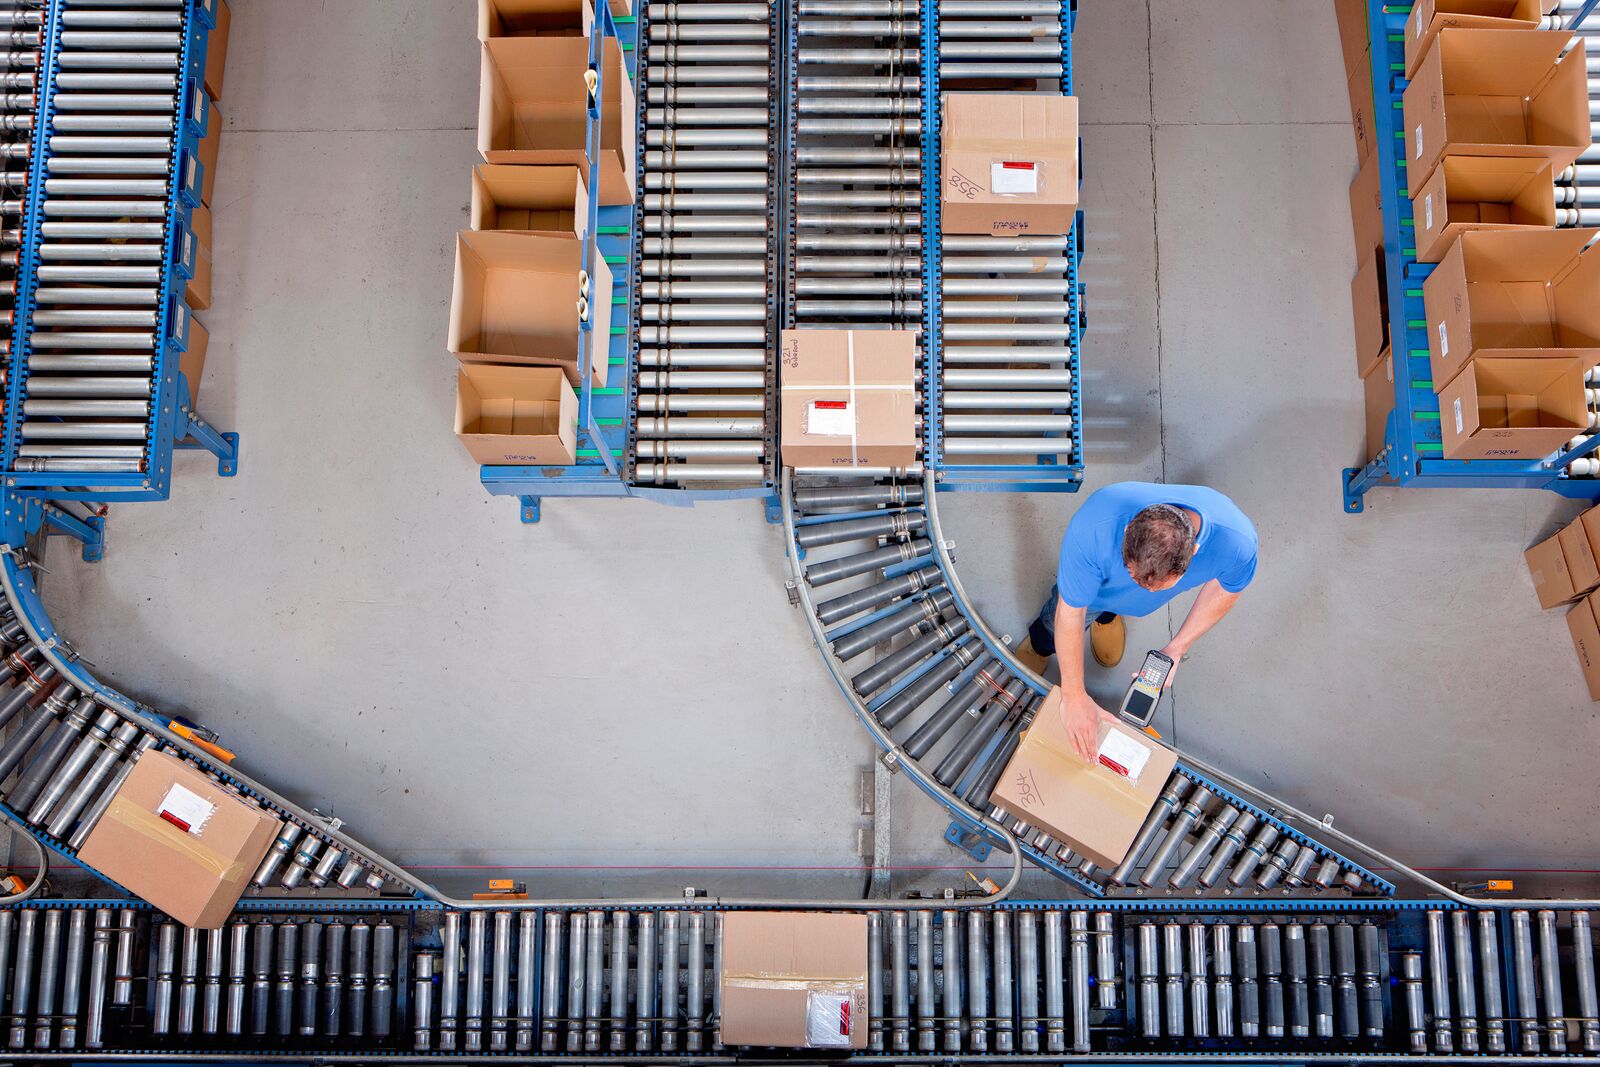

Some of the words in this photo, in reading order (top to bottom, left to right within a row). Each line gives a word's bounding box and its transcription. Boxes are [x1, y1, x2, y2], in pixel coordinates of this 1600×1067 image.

[948, 175, 979, 200] 358
[783, 347, 791, 365] 321
[1016, 773, 1036, 808] 364
[857, 994, 866, 1014] 336
